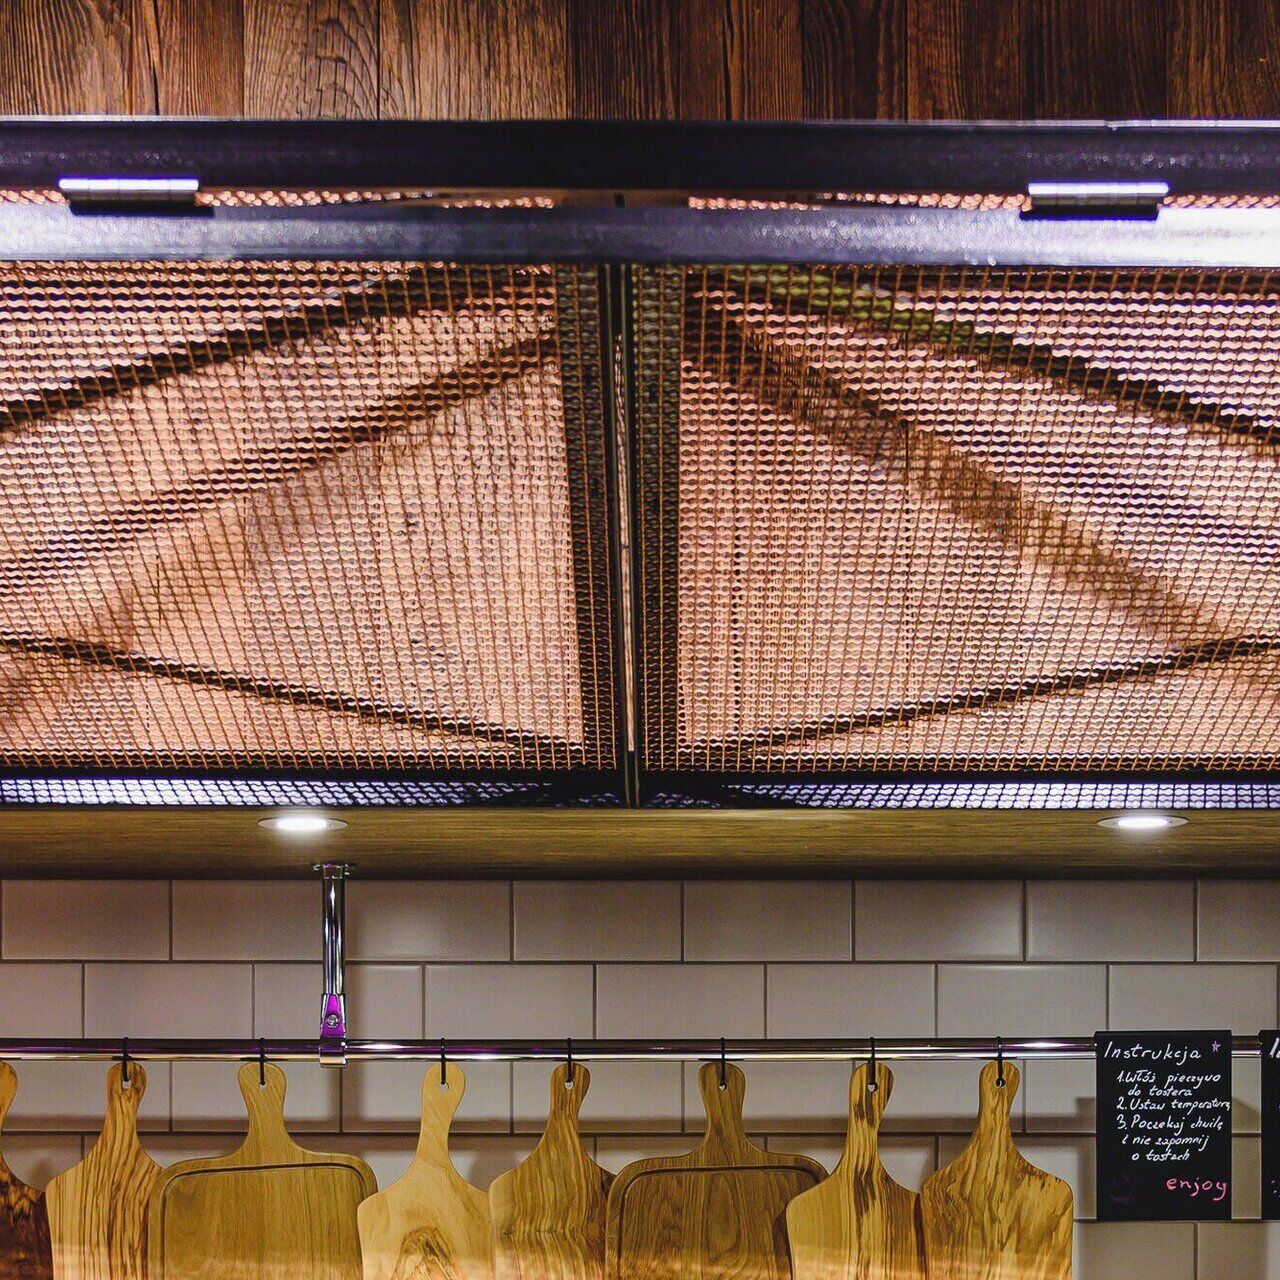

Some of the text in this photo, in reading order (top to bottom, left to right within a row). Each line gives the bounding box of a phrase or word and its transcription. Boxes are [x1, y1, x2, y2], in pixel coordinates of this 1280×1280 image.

[1104, 1041, 1202, 1066] Instrukcja
[1128, 1084, 1142, 1097] do
[1132, 1135, 1150, 1145] nie
[1131, 1152, 1140, 1161] o
[1166, 1176, 1228, 1201] enjoy
